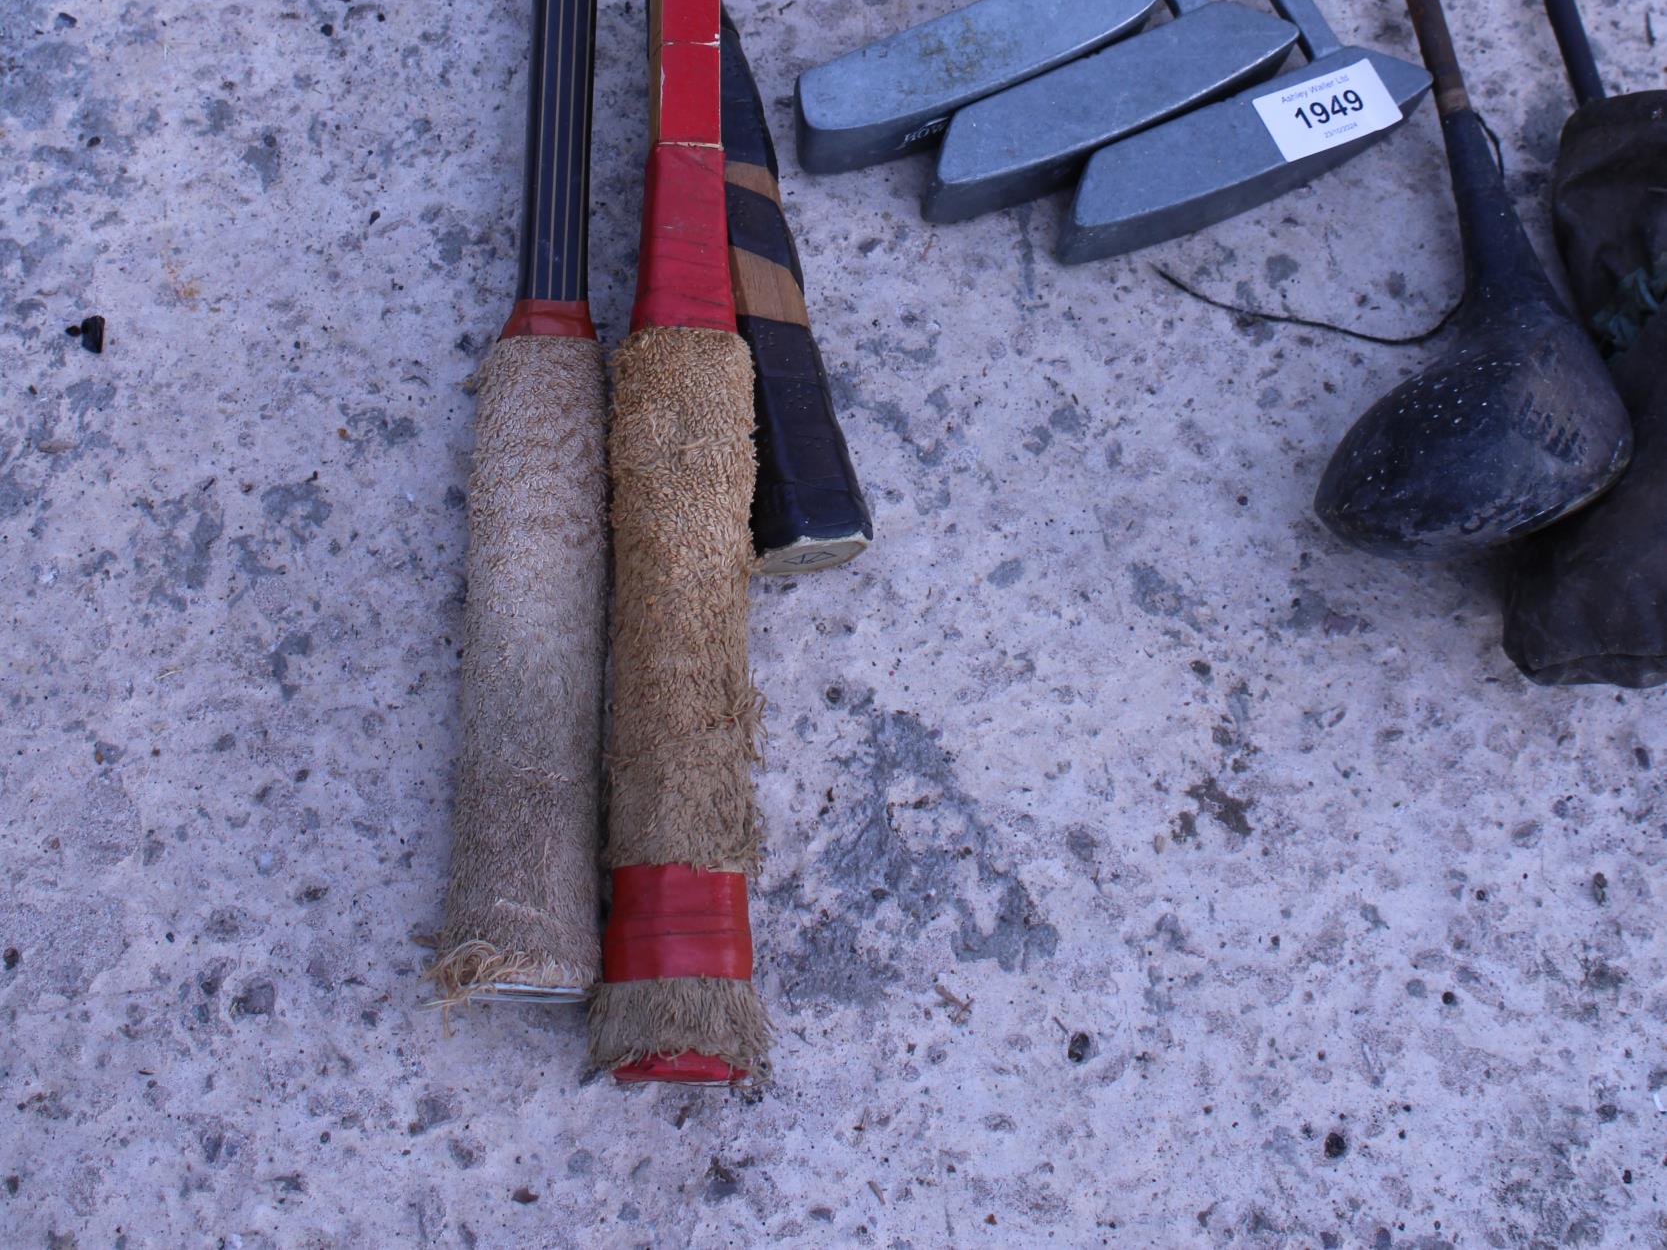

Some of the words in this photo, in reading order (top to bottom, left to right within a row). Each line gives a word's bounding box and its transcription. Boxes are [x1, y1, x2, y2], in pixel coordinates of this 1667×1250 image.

[1281, 88, 1309, 104] Ashley
[1309, 79, 1335, 94] Waller
[1294, 89, 1364, 129] 1949
